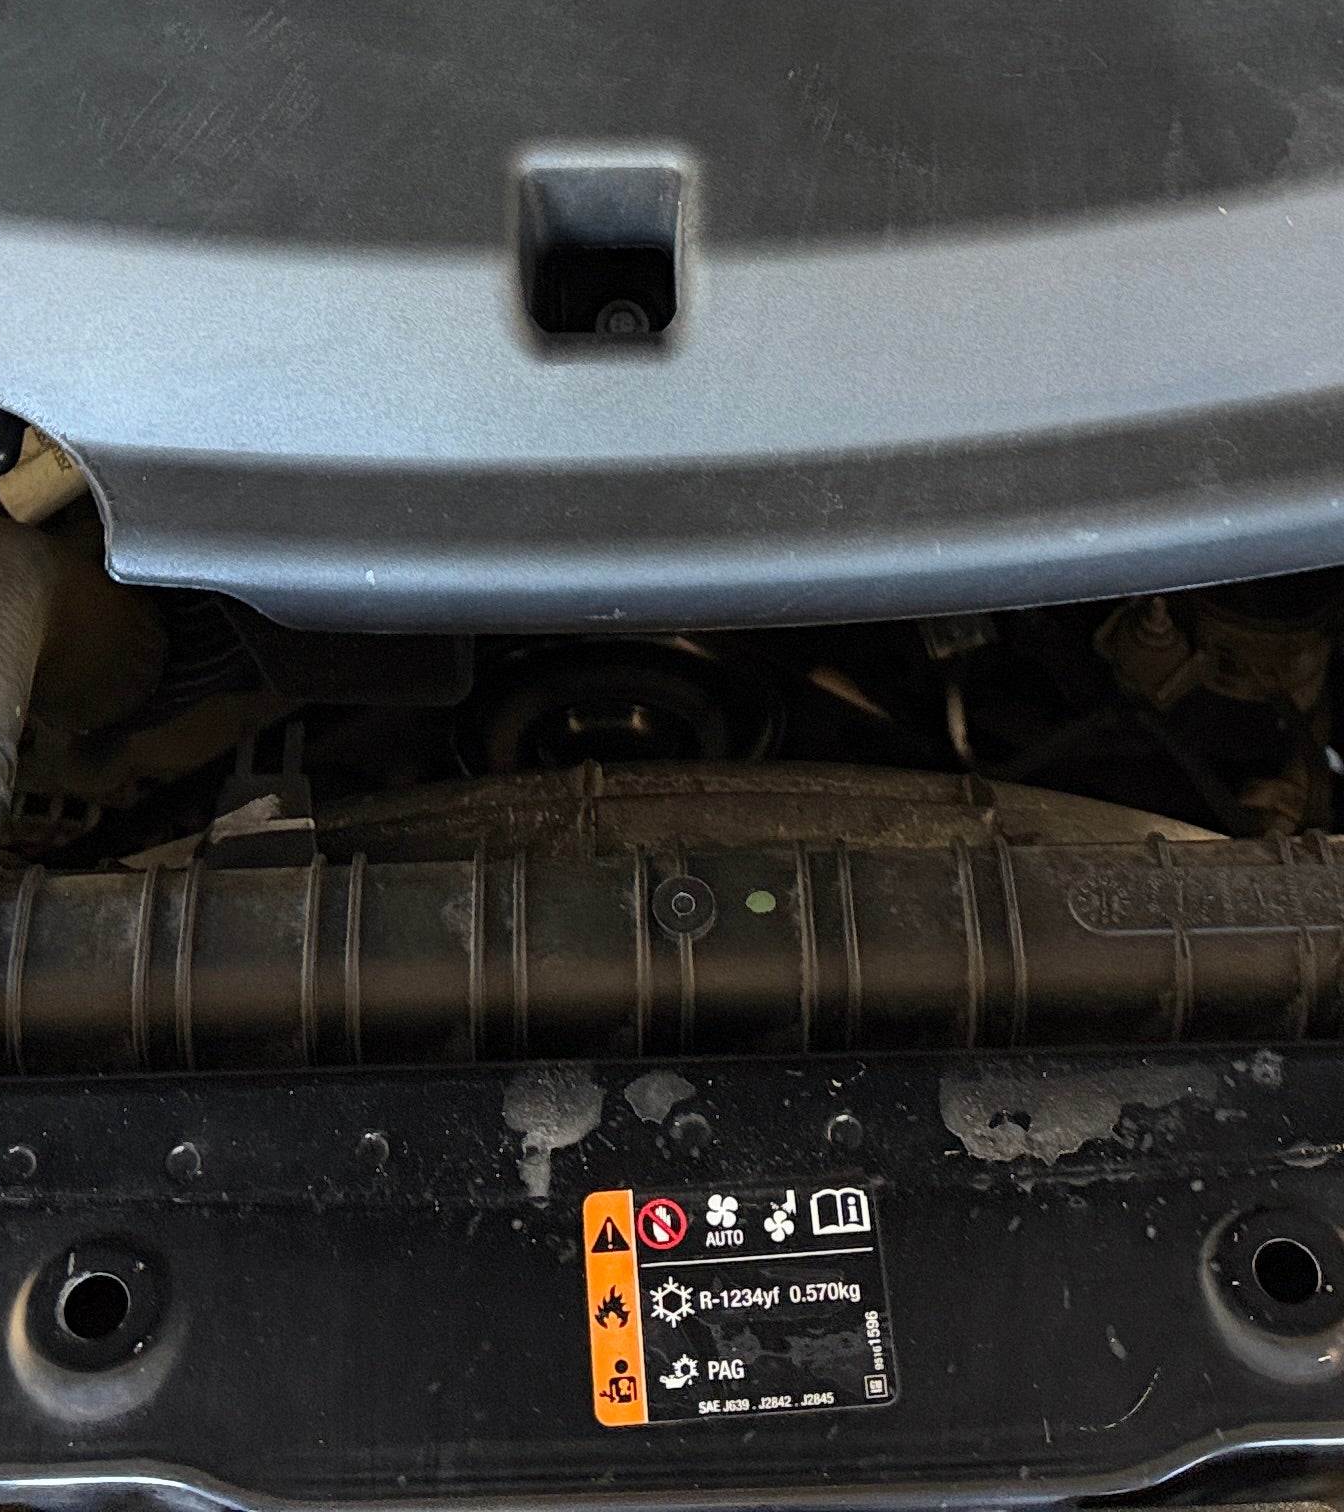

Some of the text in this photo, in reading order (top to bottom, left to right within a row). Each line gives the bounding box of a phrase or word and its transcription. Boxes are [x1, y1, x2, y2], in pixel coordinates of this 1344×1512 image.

[706, 1229, 744, 1248] AUTO
[699, 1282, 861, 1310] R-1234yf 0.570kg
[708, 1358, 745, 1380] PAG
[699, 1400, 721, 1414] SAE
[758, 1395, 792, 1410] J2842
